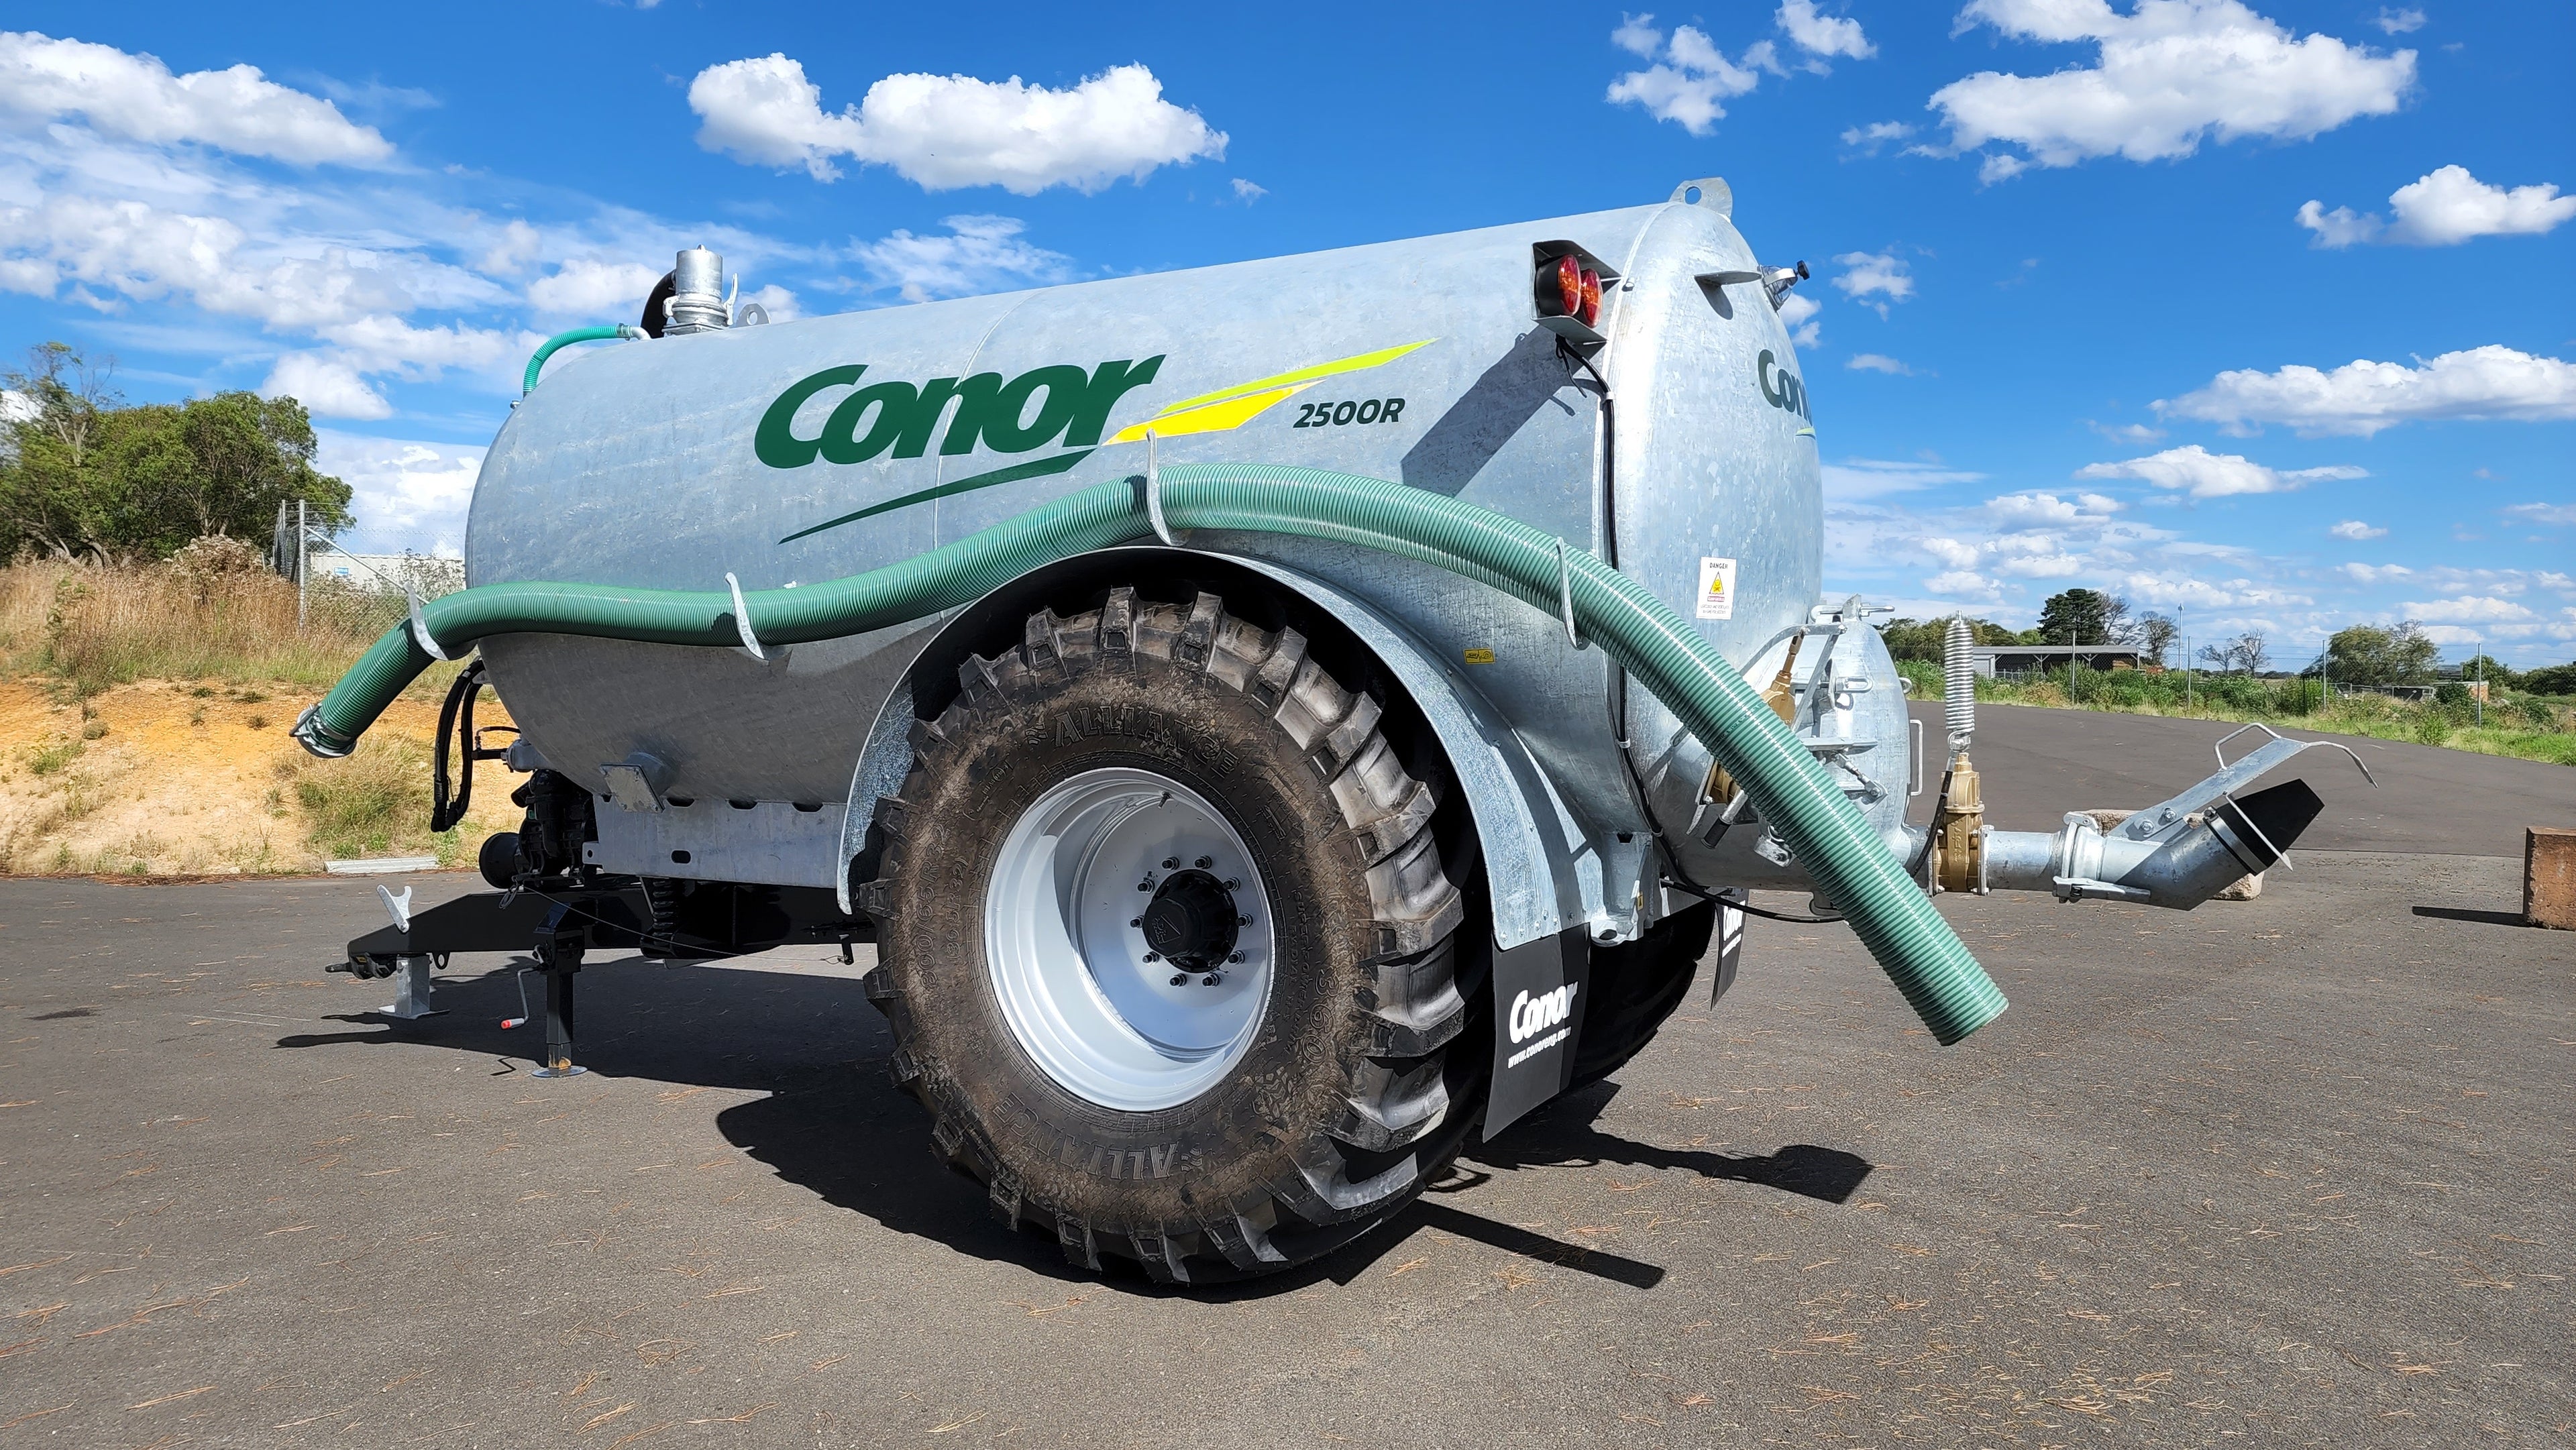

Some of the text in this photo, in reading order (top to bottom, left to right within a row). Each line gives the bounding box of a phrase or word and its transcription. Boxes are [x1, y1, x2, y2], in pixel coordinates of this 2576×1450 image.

[754, 354, 1166, 468] Conor
[1293, 398, 1405, 429] 2500R
[1303, 970, 1340, 1063] 360
[1509, 981, 1578, 1044] Conor
[992, 1092, 1179, 1180] ALLIANCE
